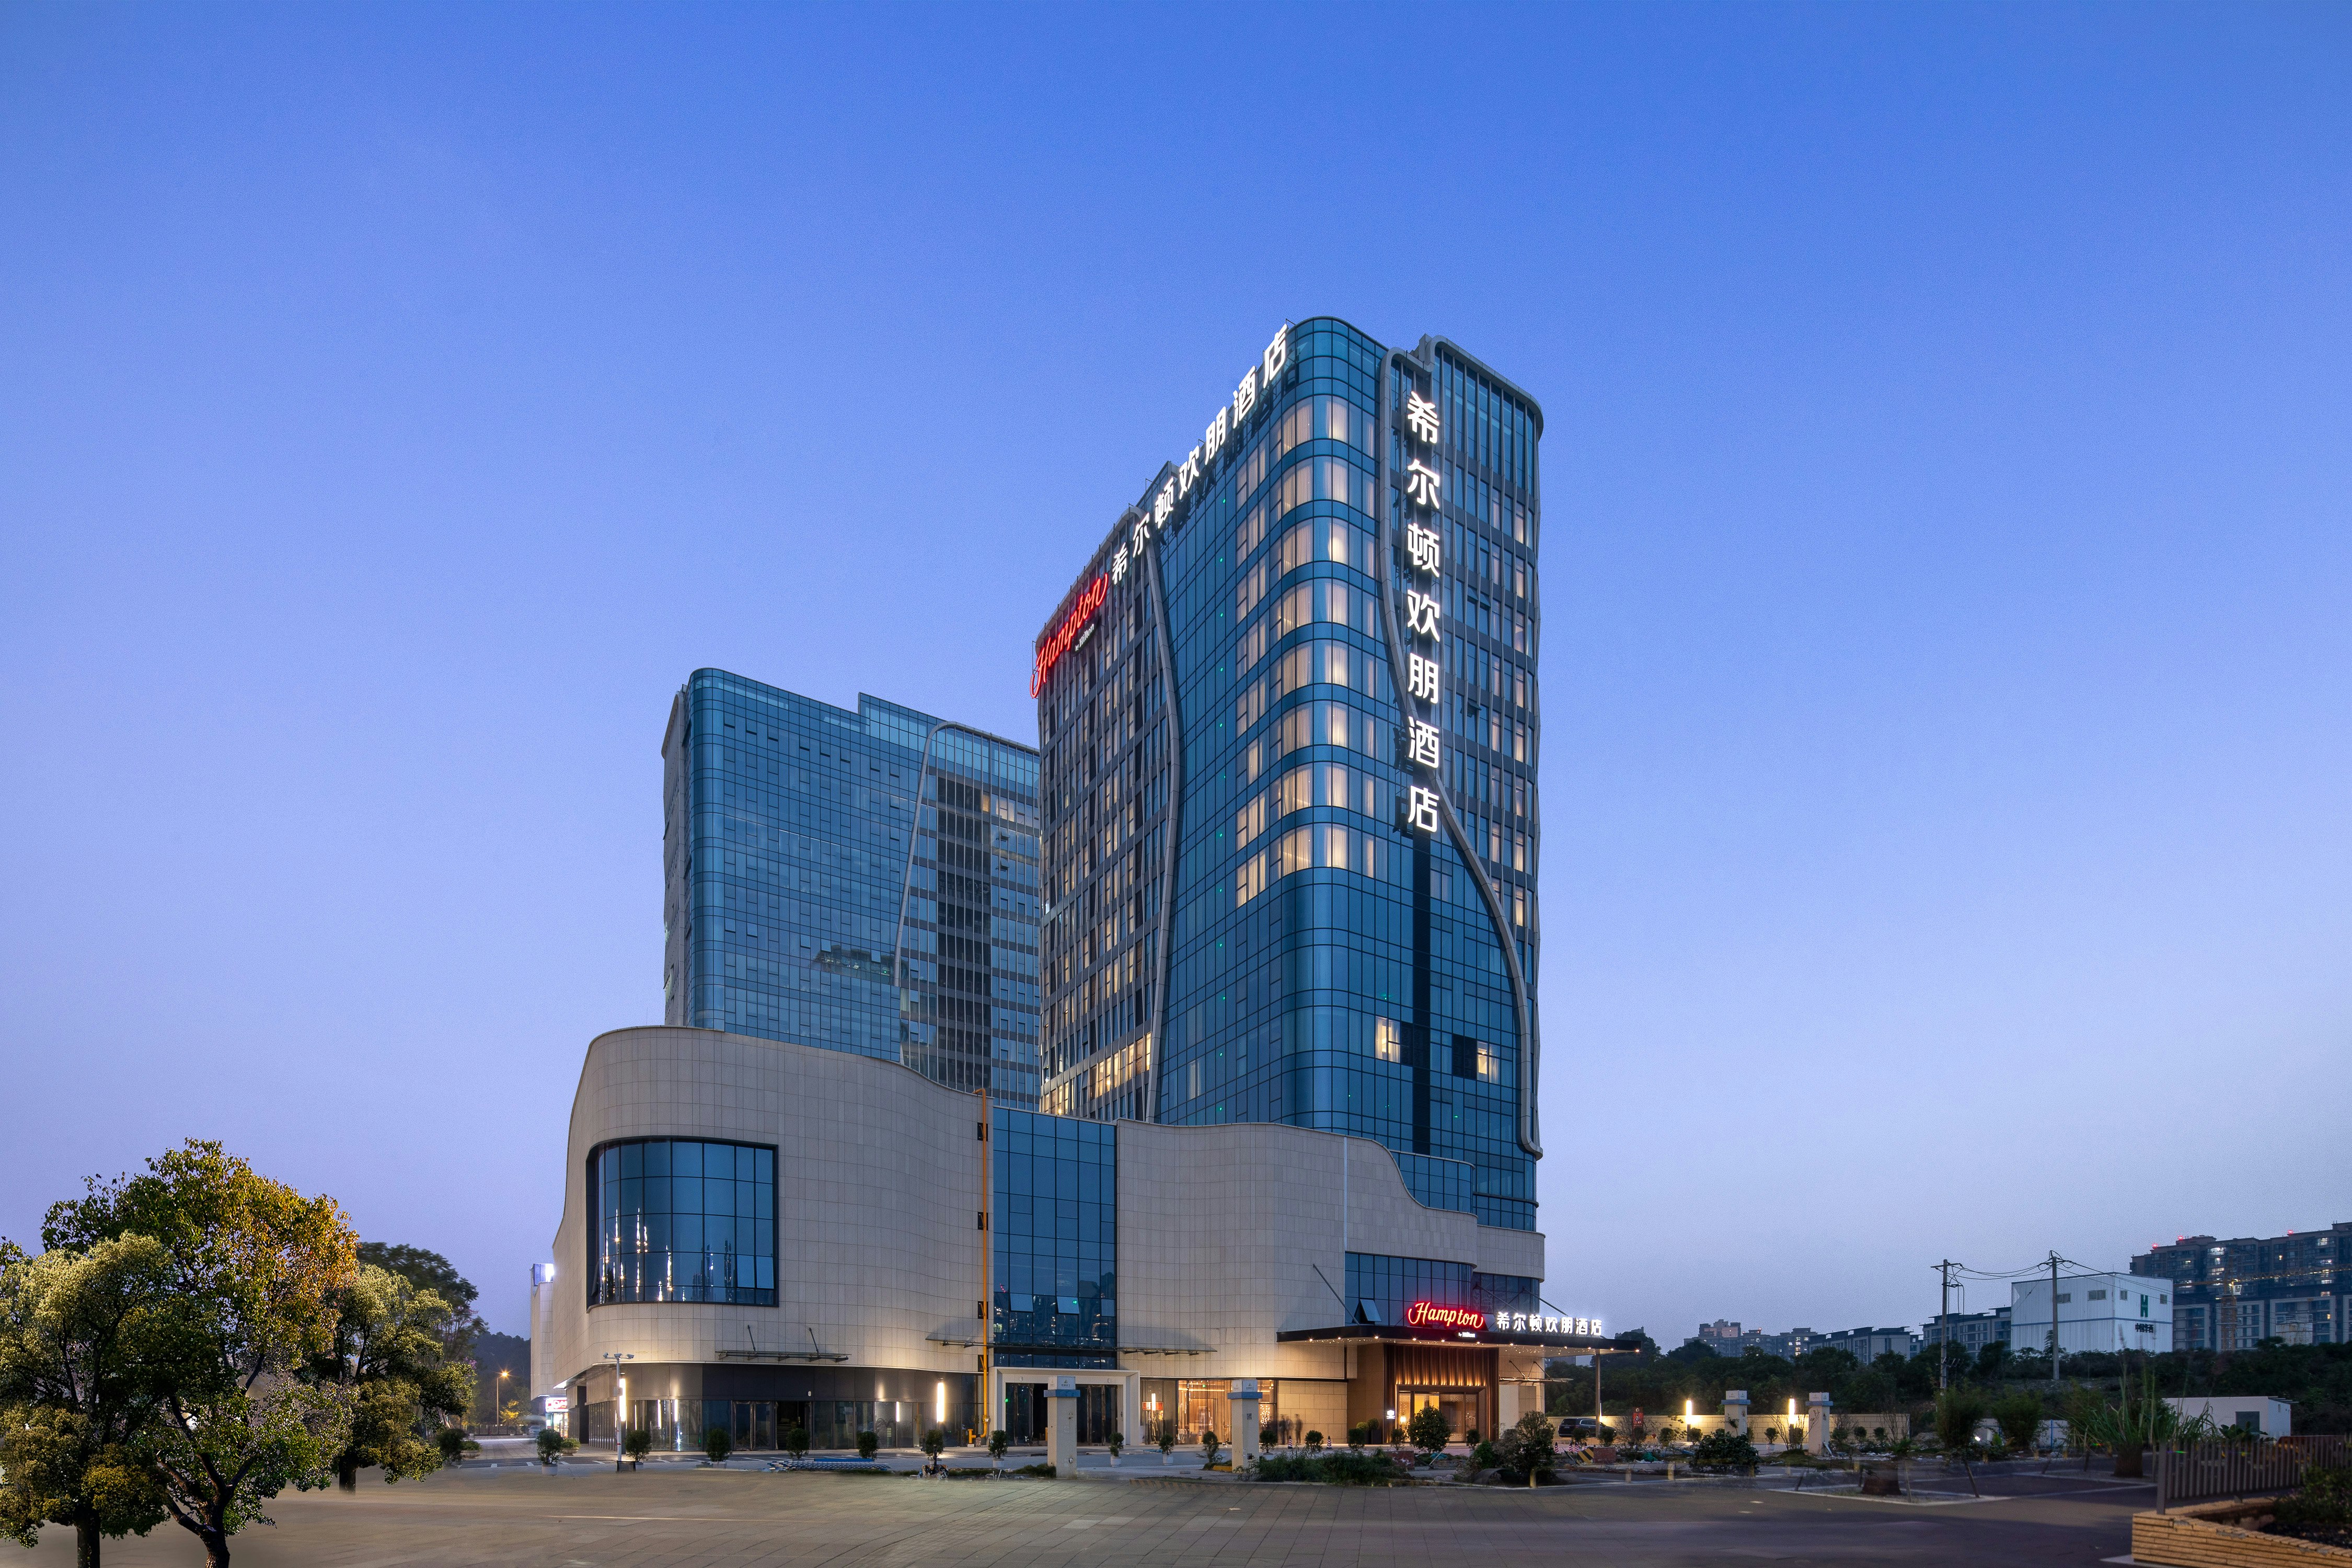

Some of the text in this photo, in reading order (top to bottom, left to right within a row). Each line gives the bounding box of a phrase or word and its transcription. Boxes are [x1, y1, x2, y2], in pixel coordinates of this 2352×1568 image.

[1112, 324, 1288, 584] 希尔顿欢朋酒店
[1030, 573, 1108, 699] Hampton
[1079, 624, 1094, 648] Hilton
[1407, 391, 1440, 834] 希尔顿欢朋酒店
[1408, 1302, 1483, 1328] Hampton
[1497, 1311, 1602, 1336] 希尔顿欢朋酒店
